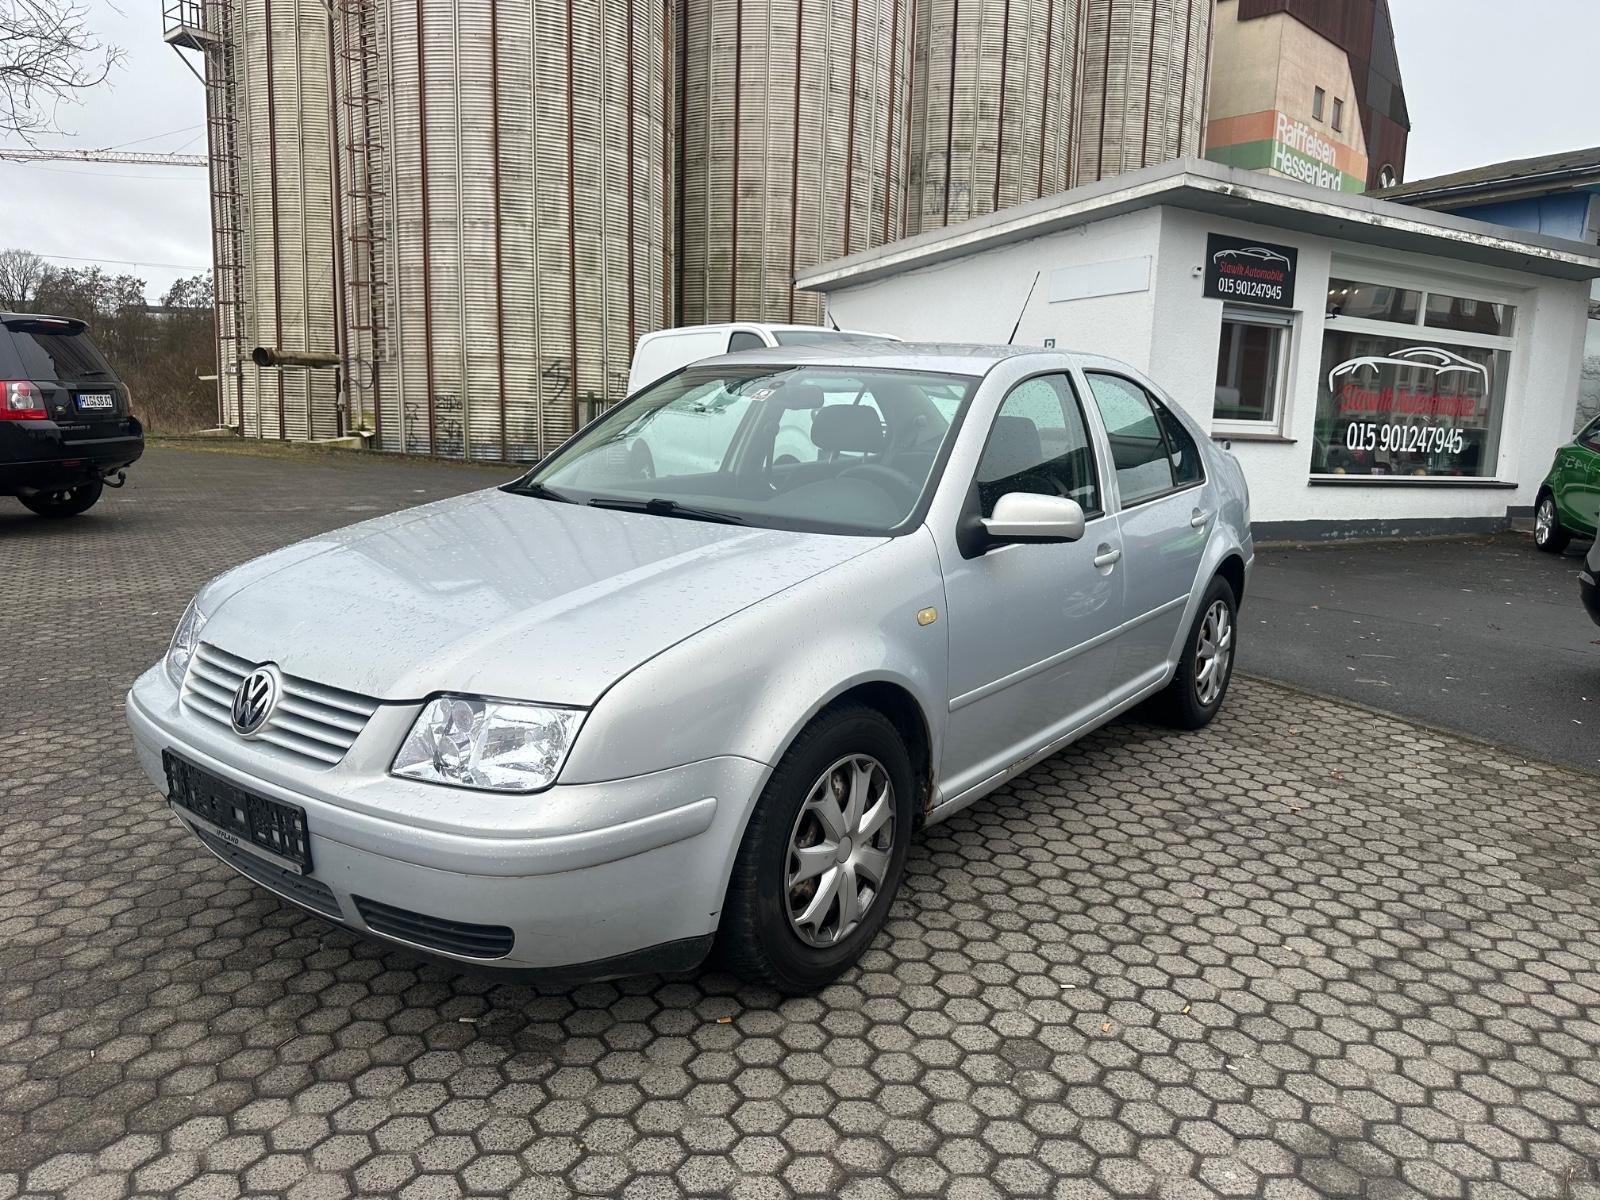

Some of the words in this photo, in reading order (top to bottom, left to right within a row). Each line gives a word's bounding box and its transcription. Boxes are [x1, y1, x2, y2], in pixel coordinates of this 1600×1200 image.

[1276, 112, 1336, 166] Raiffeisen
[1273, 141, 1342, 191] Hessenland
[1218, 277, 1234, 293] 015
[1235, 280, 1282, 299] 901247945
[1244, 265, 1285, 281] Automobile
[1396, 387, 1476, 417] Automobile
[1346, 422, 1377, 451] 015
[1379, 424, 1464, 454] 901247945
